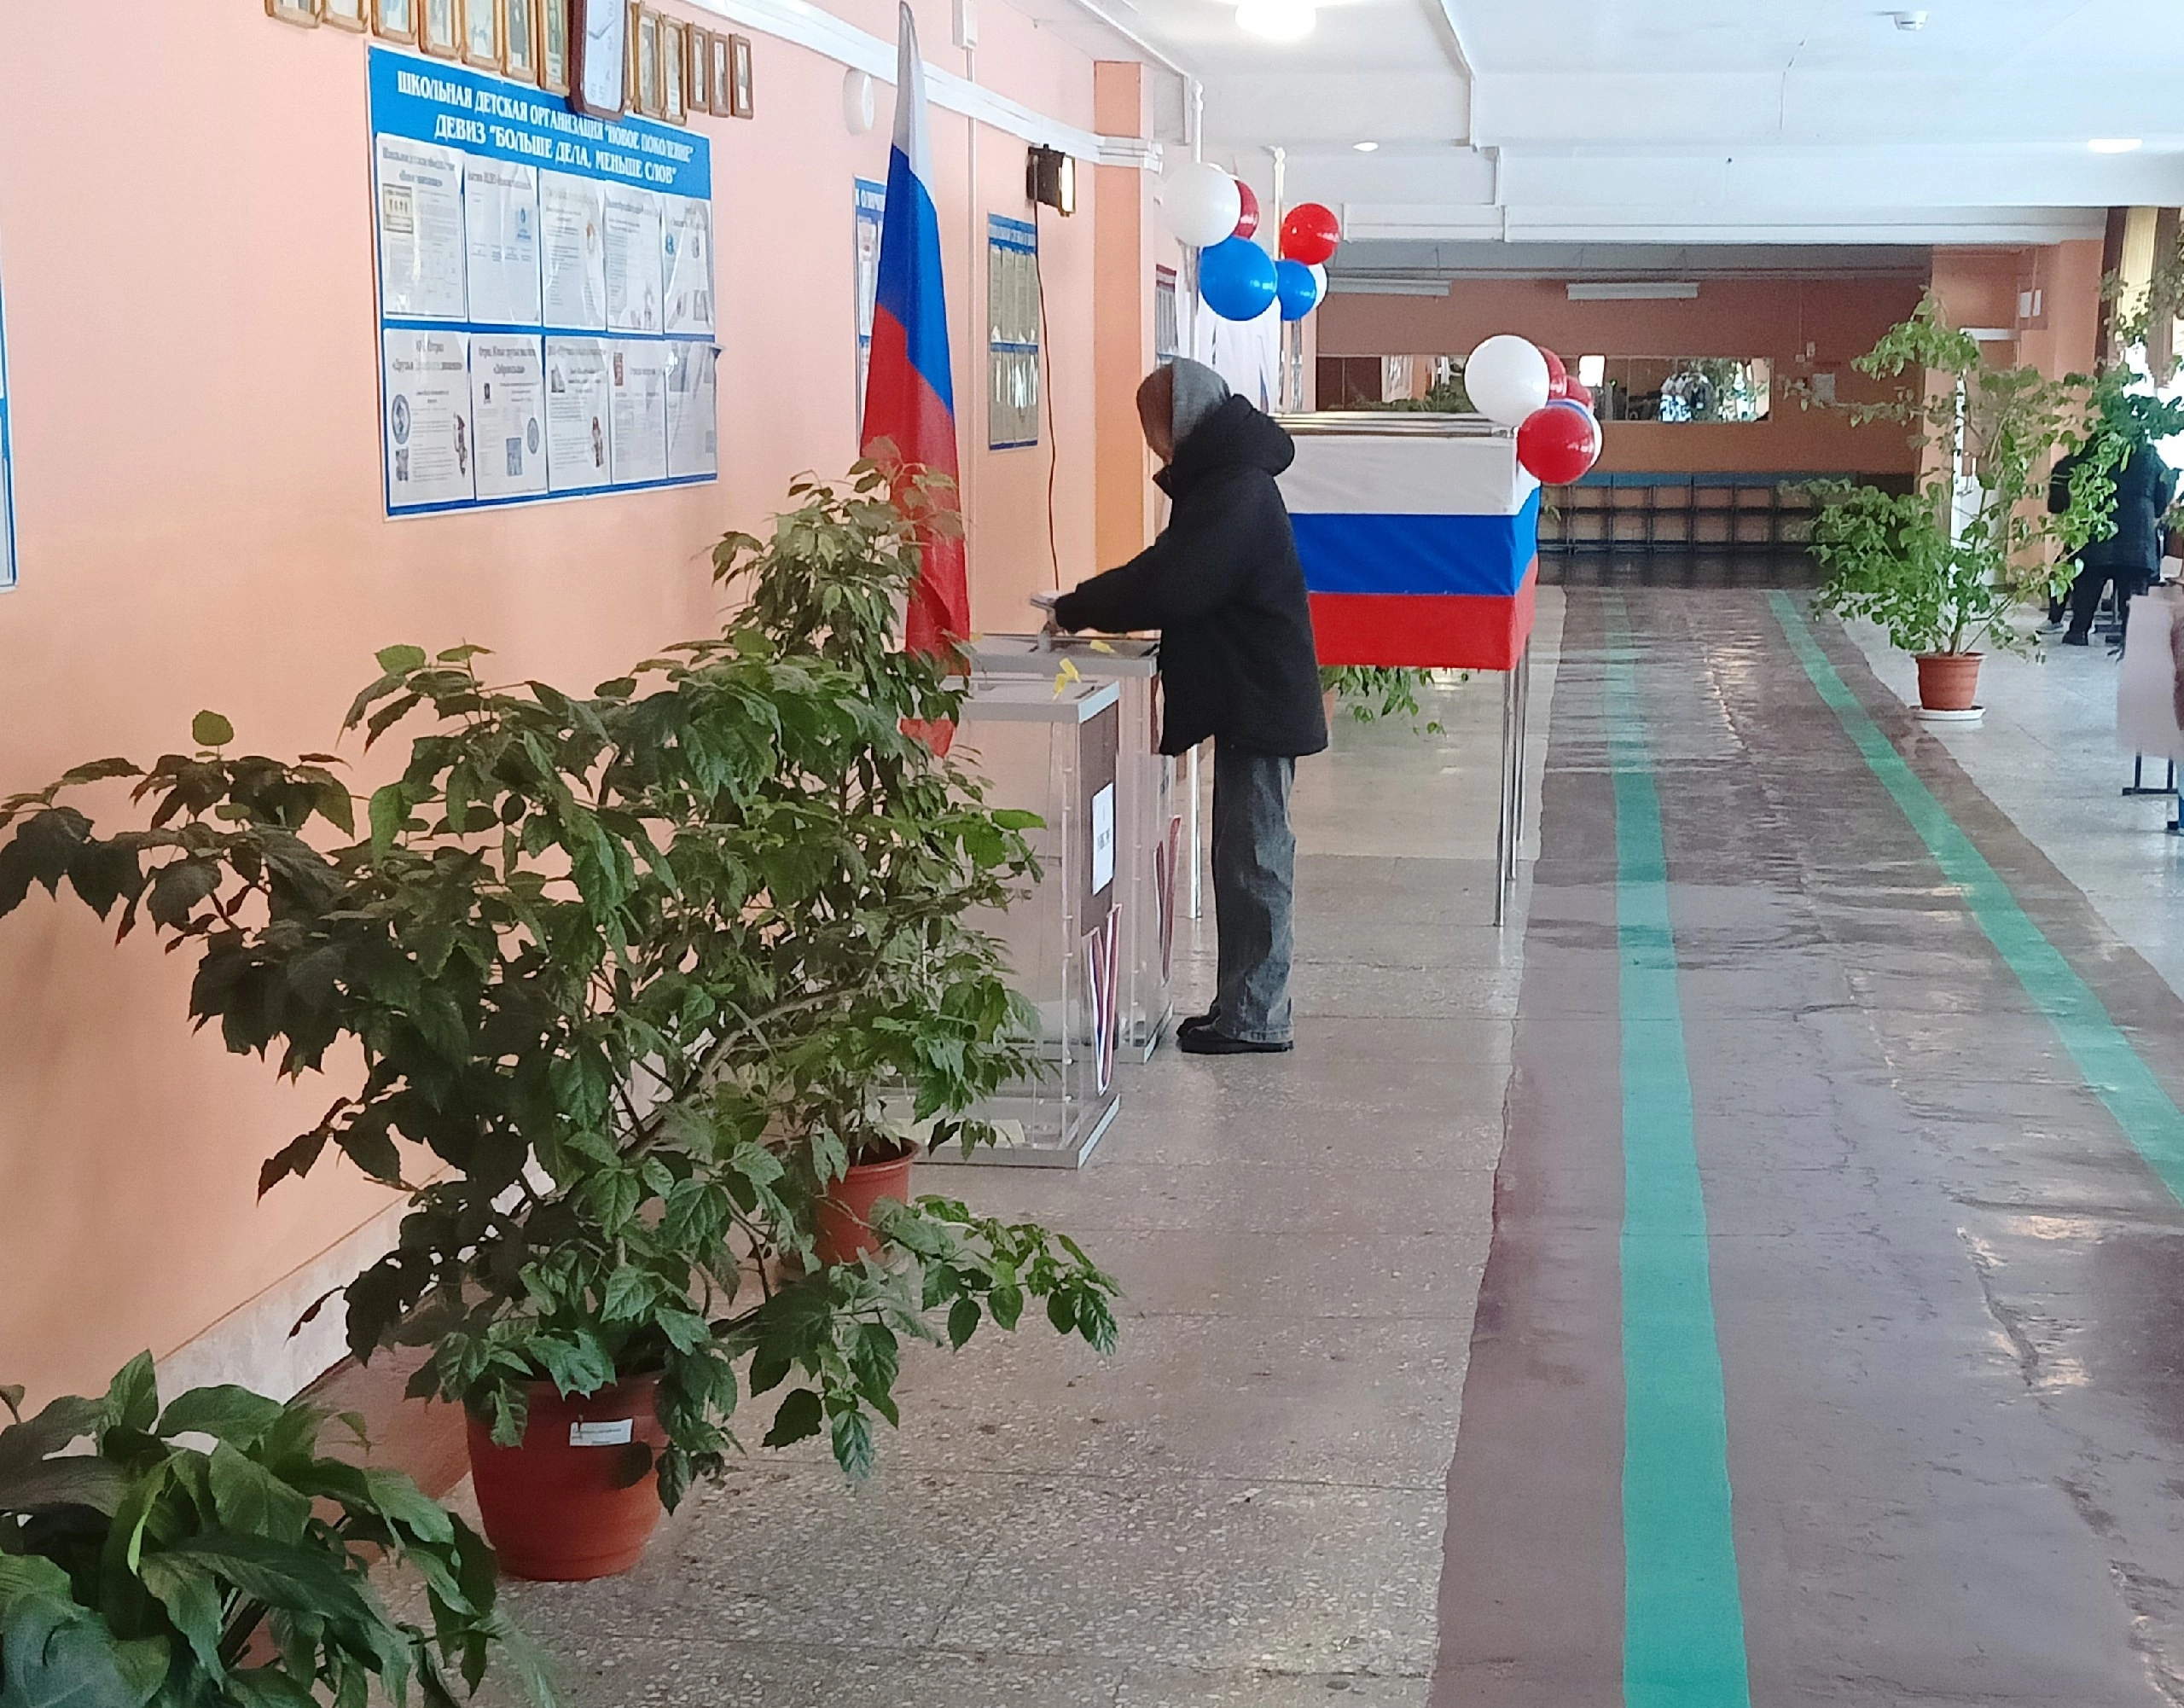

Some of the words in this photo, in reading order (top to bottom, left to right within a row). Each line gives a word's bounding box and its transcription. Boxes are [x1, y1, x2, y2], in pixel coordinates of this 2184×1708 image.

[398, 70, 472, 108] ШКОЛЬНАЯ
[474, 90, 527, 122] ДЕТСКАЯ
[530, 105, 603, 142] ОРГАНИЗАЦИЯ
[434, 113, 486, 144] ДЕВИЗ
[490, 125, 553, 159] "БОЛЬШЕ
[555, 142, 592, 170] ДЕЛА,
[595, 150, 642, 178] МЕНЬШЕ
[645, 161, 677, 184] СЛОВ"
